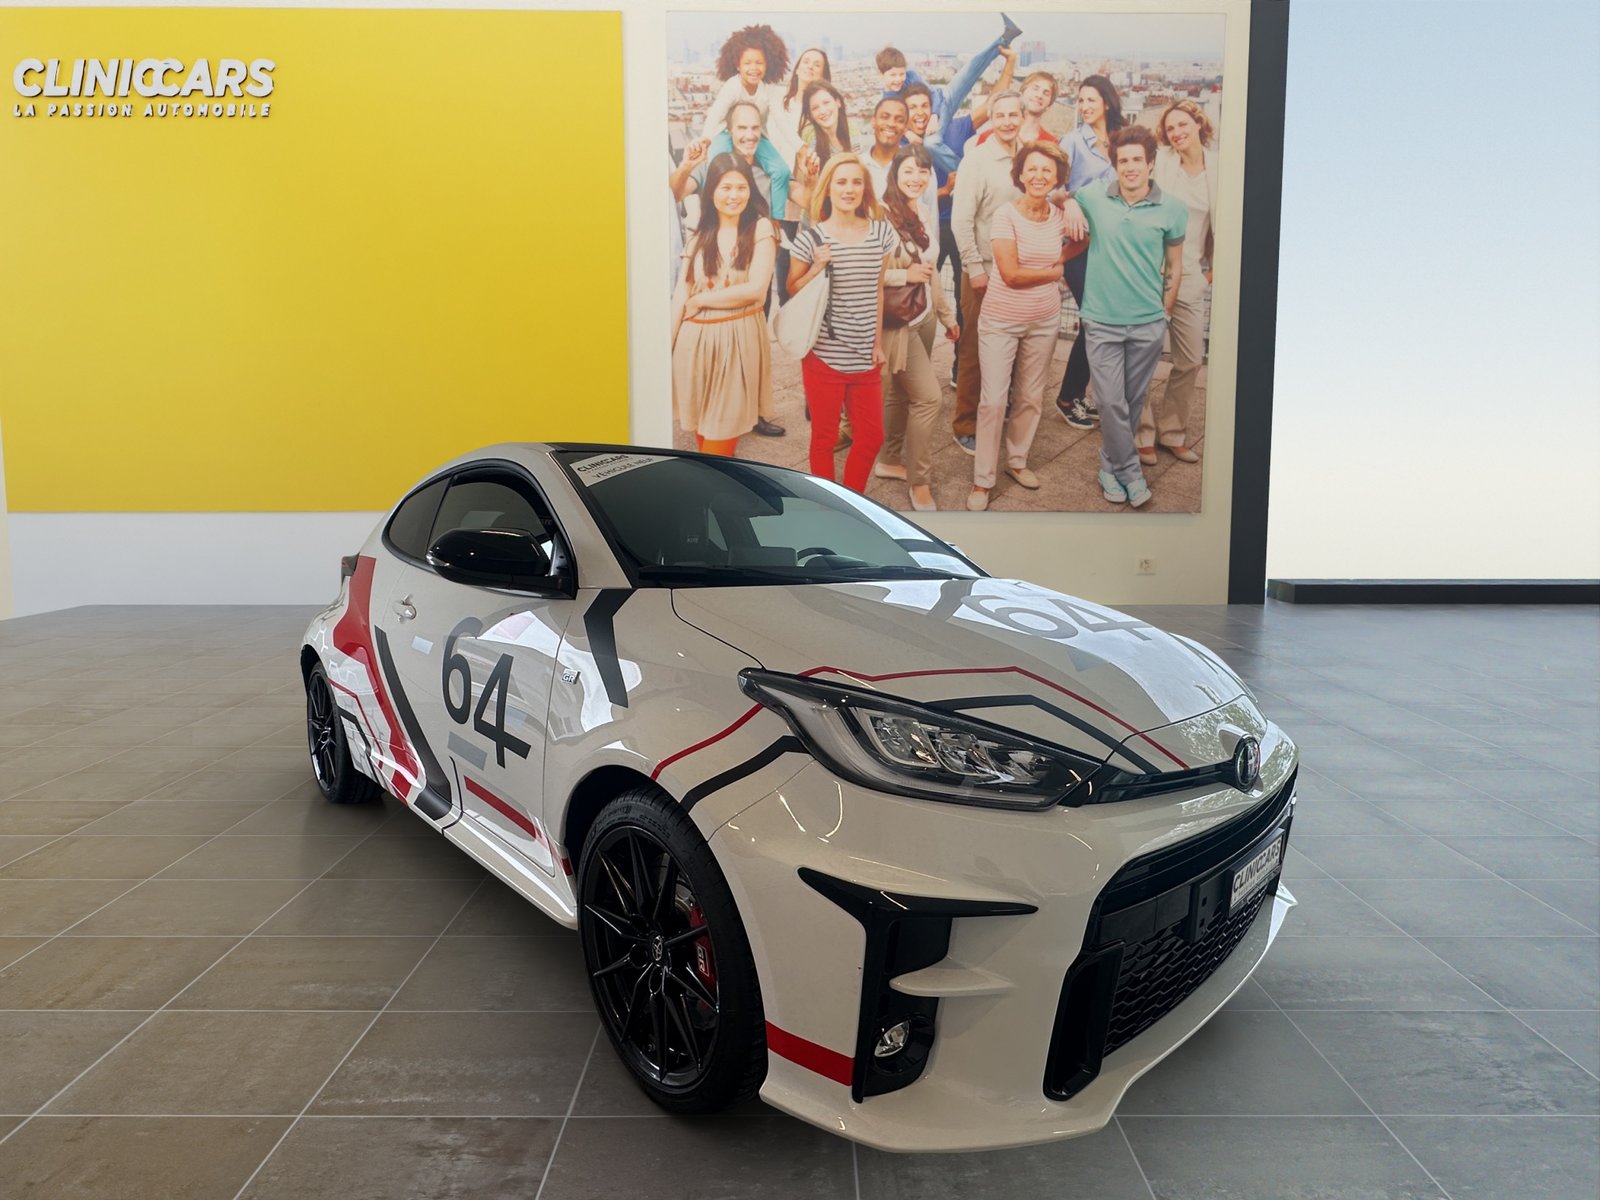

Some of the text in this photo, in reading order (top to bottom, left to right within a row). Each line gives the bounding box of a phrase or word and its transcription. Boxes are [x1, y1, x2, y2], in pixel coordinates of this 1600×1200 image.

[13, 58, 276, 97] CLINICCARS
[13, 103, 271, 118] LA PASSION AUTOMOBILE
[960, 595, 1152, 641] 64
[442, 617, 532, 769] 64
[562, 673, 575, 683] GR
[1233, 840, 1281, 893] CLINICCARS
